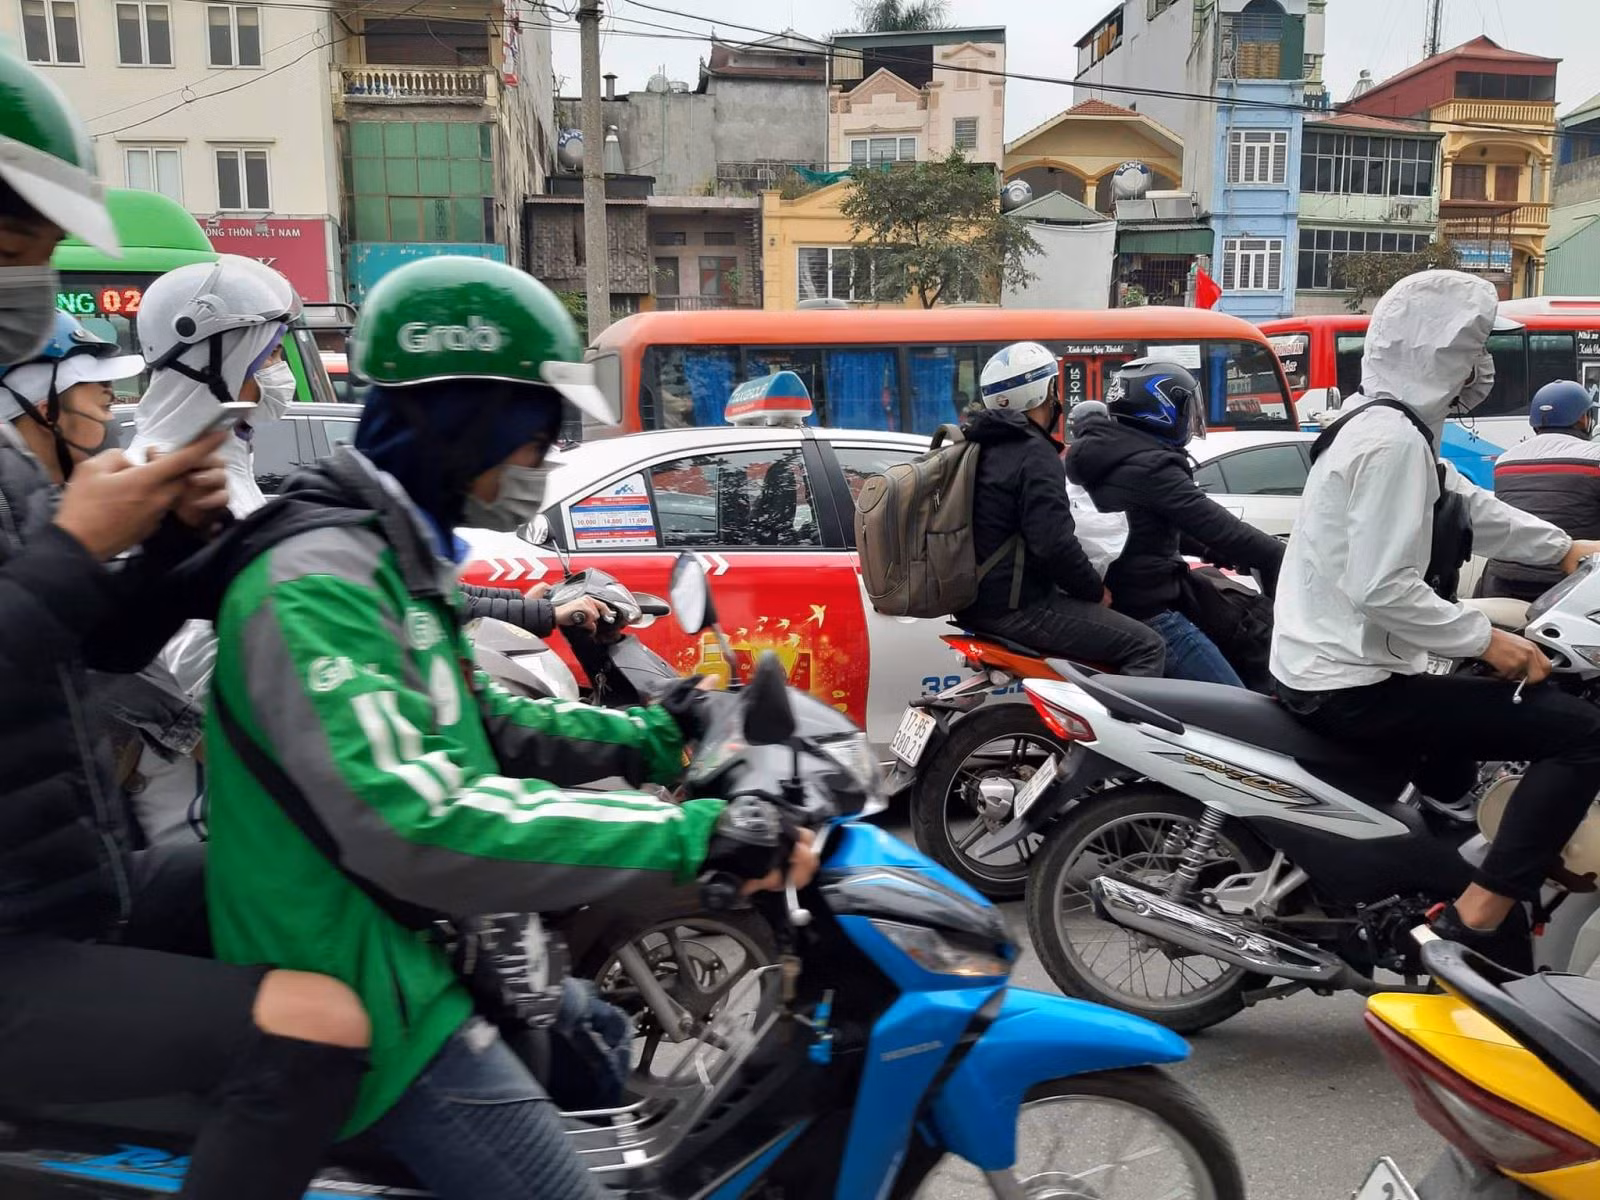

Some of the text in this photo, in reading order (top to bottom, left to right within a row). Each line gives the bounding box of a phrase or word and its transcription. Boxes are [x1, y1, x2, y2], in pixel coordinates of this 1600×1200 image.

[202, 227, 225, 237] ÔNG
[228, 227, 252, 237] THÔN
[279, 228, 300, 237] NAM
[103, 290, 142, 312] 02
[398, 315, 503, 353] Grab
[892, 730, 922, 762] 380.21
